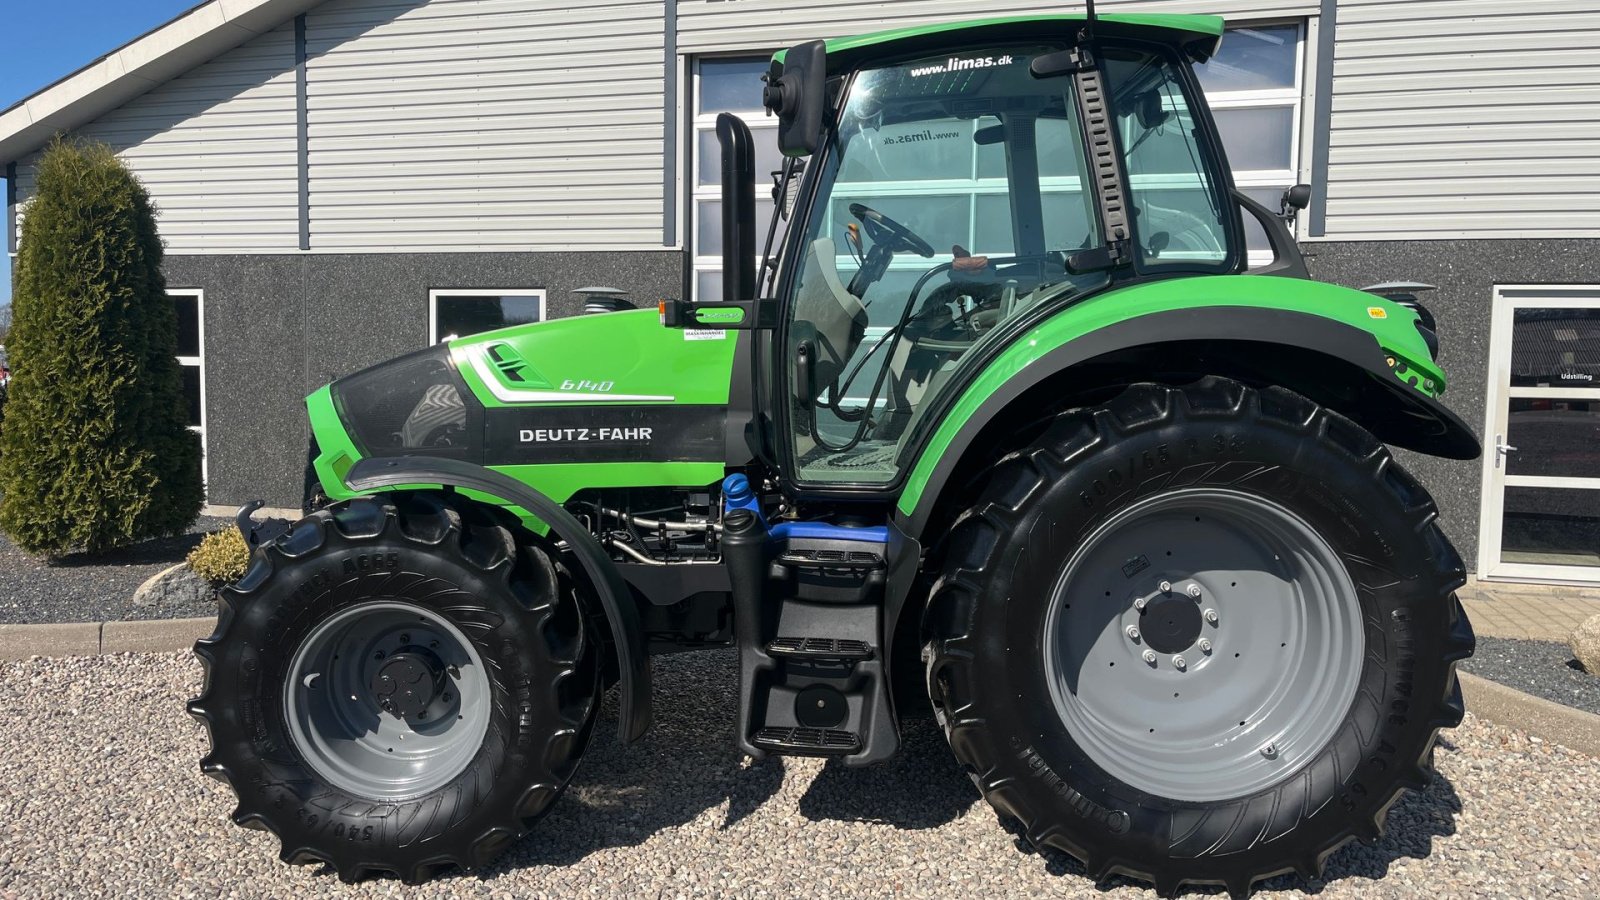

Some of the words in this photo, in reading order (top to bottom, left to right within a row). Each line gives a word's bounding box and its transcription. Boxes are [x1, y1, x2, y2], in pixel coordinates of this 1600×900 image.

[910, 55, 1013, 77] www.limas.dk
[1561, 373, 1593, 381] Udstilling
[559, 378, 615, 393] 6140
[519, 427, 653, 443] DEUTZ-FAHR
